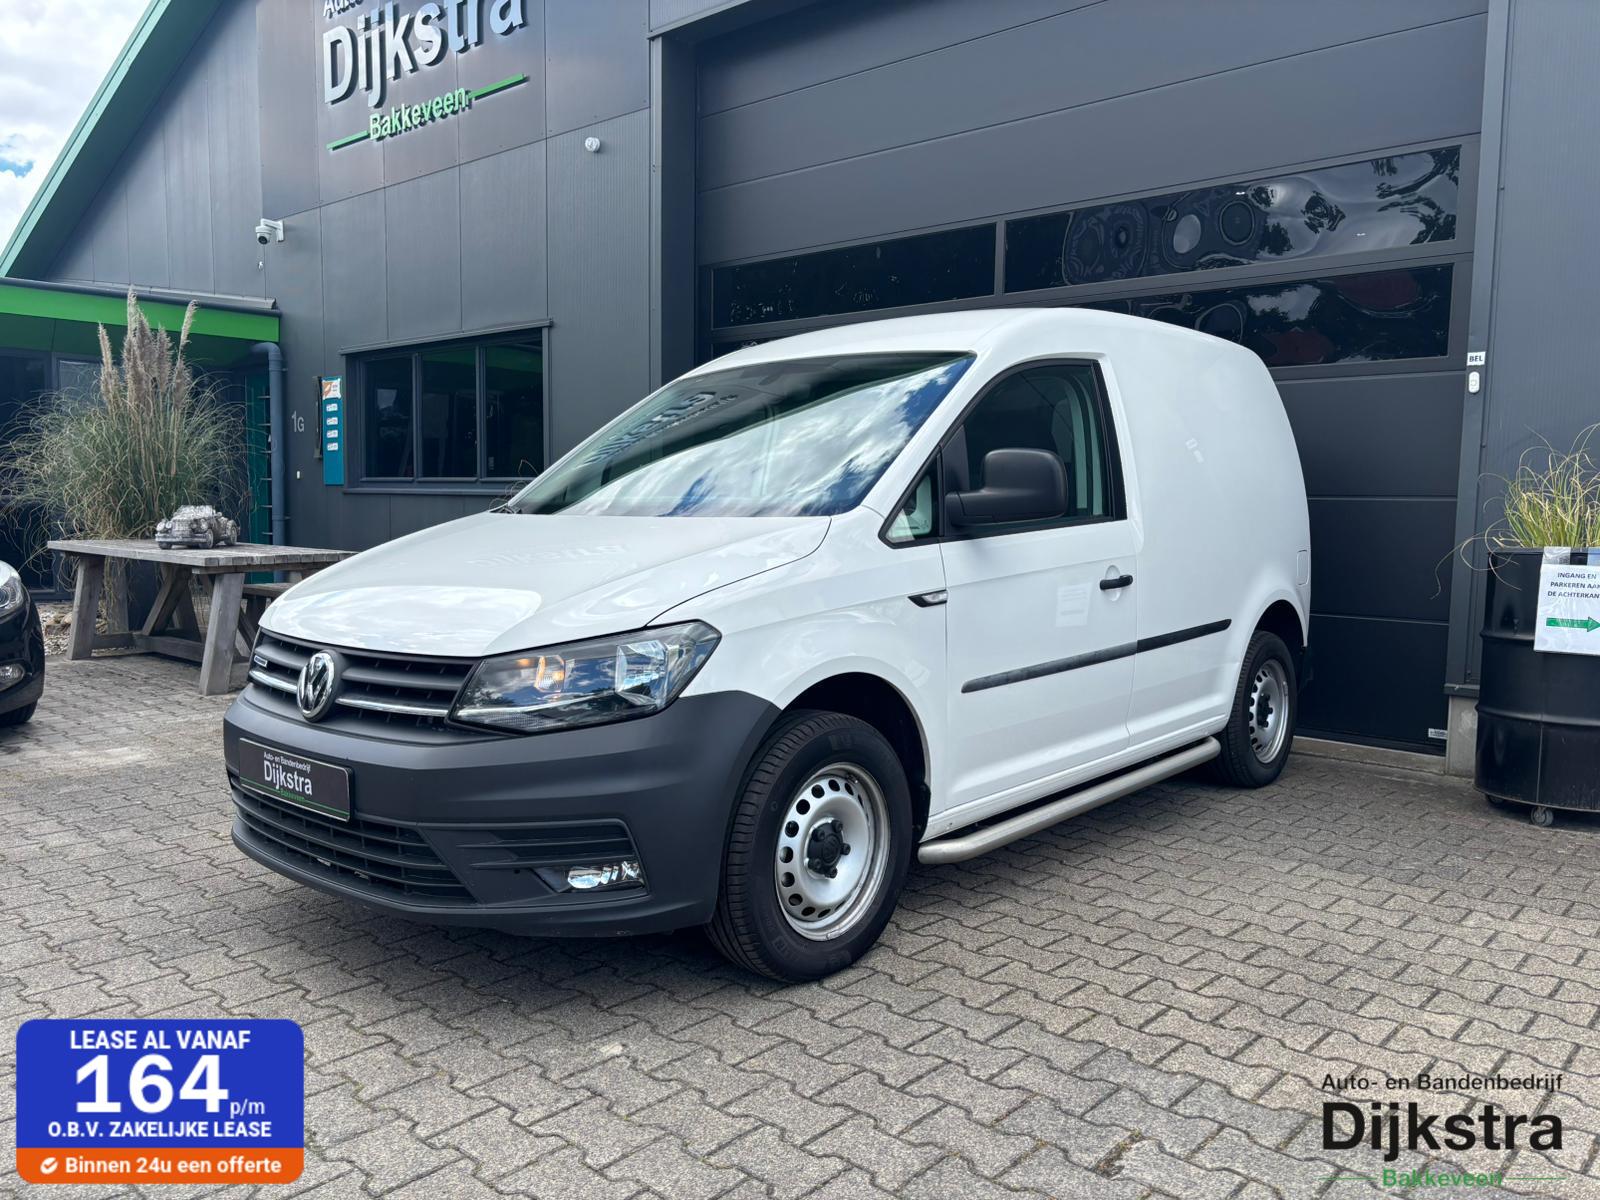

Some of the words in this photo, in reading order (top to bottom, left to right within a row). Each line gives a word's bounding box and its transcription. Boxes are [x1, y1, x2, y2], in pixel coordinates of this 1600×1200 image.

[322, 0, 524, 107] Dijkstra
[368, 87, 467, 140] Bakkeveen
[1469, 355, 1484, 363] BEL
[291, 410, 305, 433] 1G
[1550, 581, 1586, 589] PARKEREN
[1557, 591, 1600, 599] ACHTERKAN
[263, 760, 313, 796] Dijkstra
